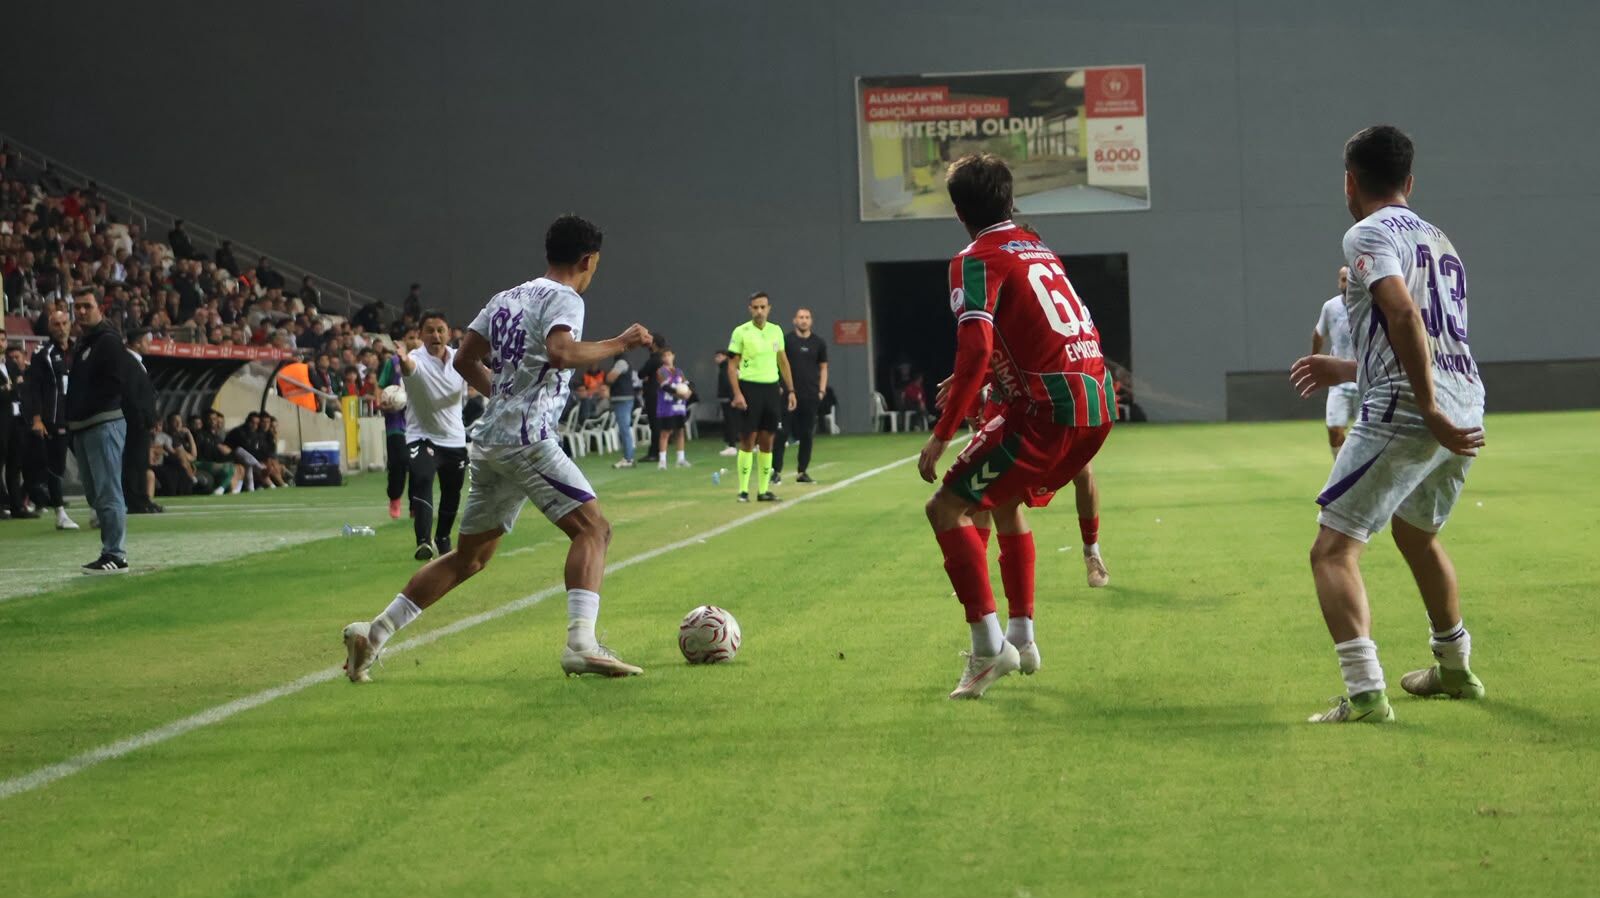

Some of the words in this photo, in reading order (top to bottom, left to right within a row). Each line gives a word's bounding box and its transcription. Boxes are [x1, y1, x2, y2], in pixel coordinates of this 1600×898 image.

[920, 103, 966, 115] MERKEZİ
[982, 117, 1043, 136] OLDU!
[1094, 148, 1141, 163] 8.000
[1416, 243, 1467, 342] 33
